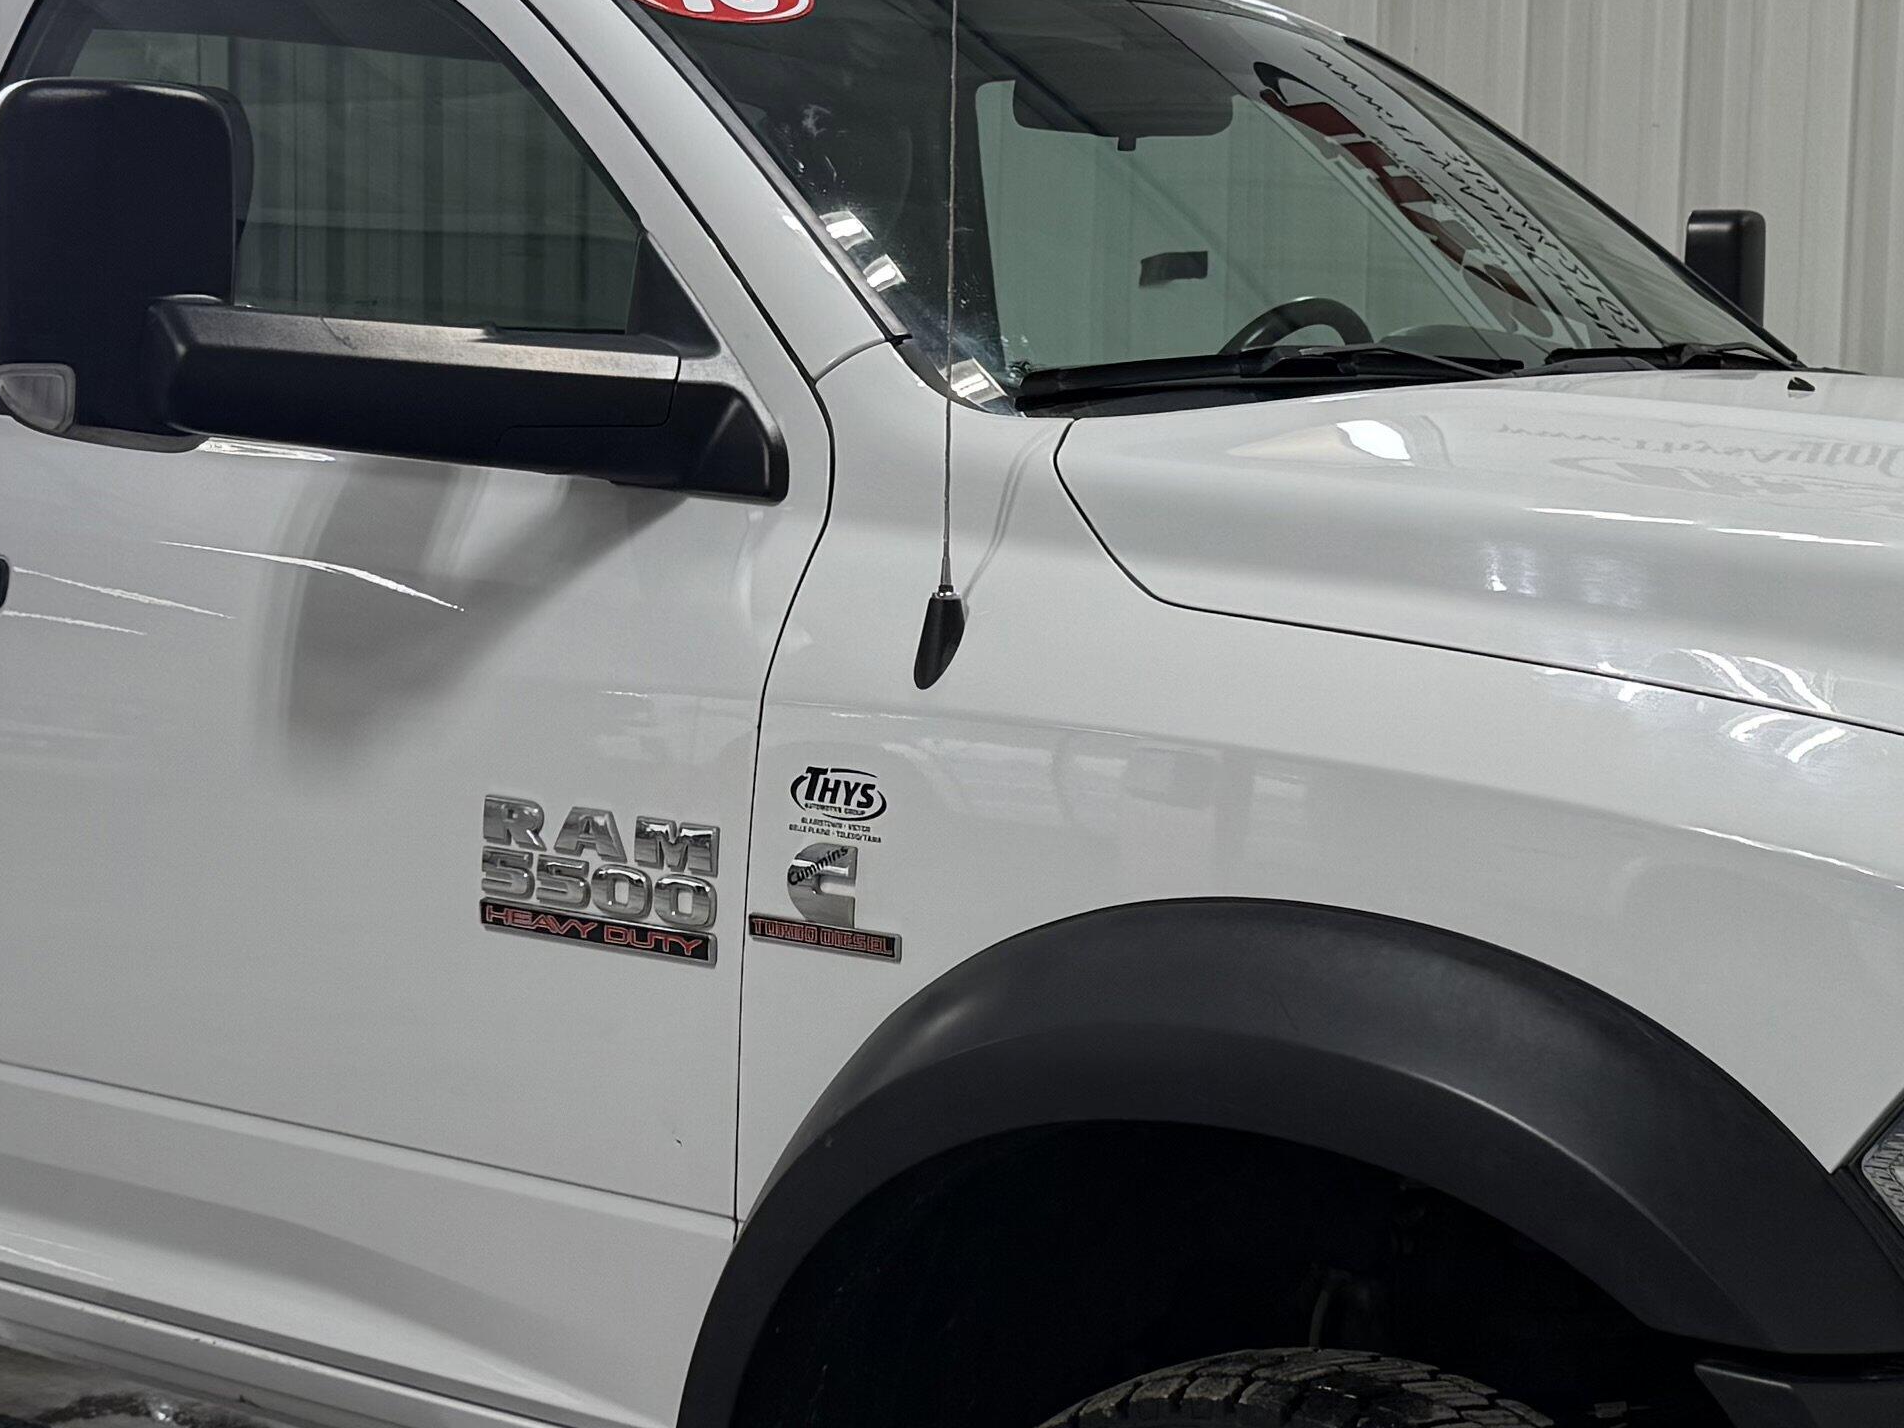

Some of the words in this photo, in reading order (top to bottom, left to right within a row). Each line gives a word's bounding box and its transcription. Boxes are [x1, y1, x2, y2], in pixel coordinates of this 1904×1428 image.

[804, 765, 877, 810] THYS
[482, 793, 721, 878] RAM
[481, 845, 718, 932] 5500
[788, 845, 849, 886] Cummins
[485, 904, 598, 940] HEAVY
[604, 924, 703, 957] DUTY
